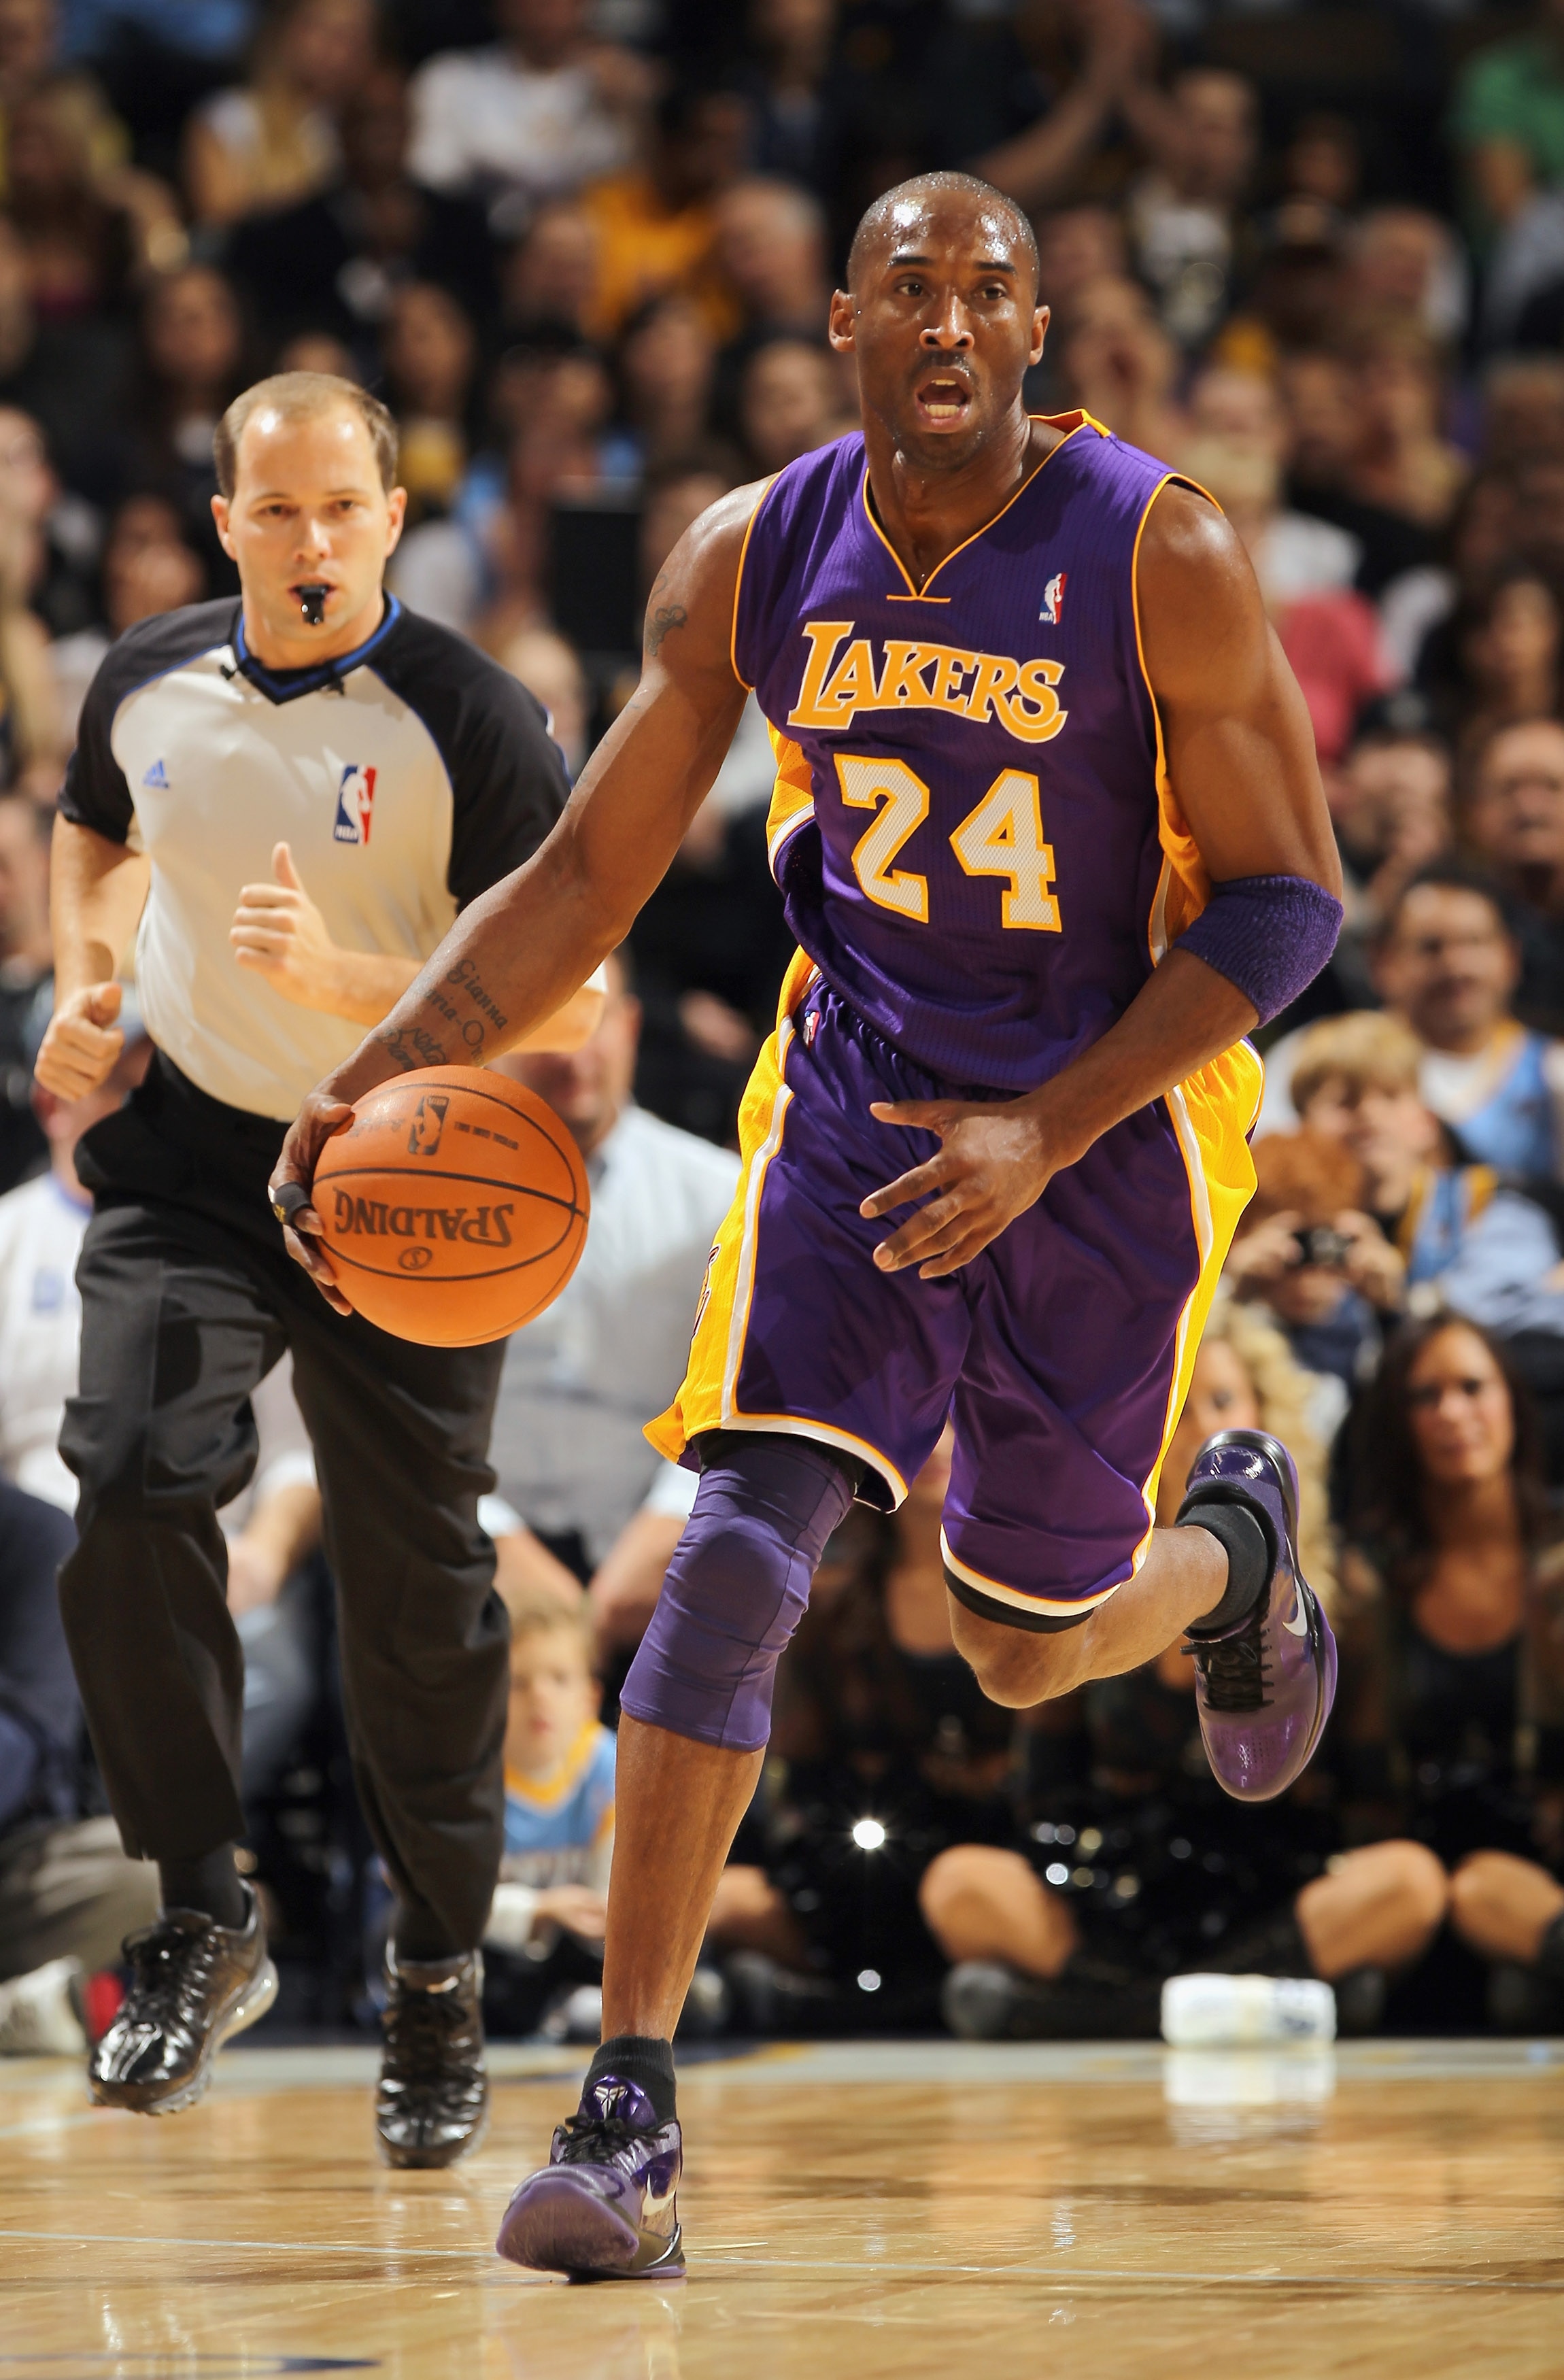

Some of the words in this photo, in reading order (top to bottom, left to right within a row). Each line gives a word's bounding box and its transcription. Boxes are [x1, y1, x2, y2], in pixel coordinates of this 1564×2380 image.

[787, 621, 1068, 743] LAKERS
[834, 753, 1061, 933] 24
[446, 959, 509, 1030] Gianna
[333, 1186, 513, 1248] SPALDING
